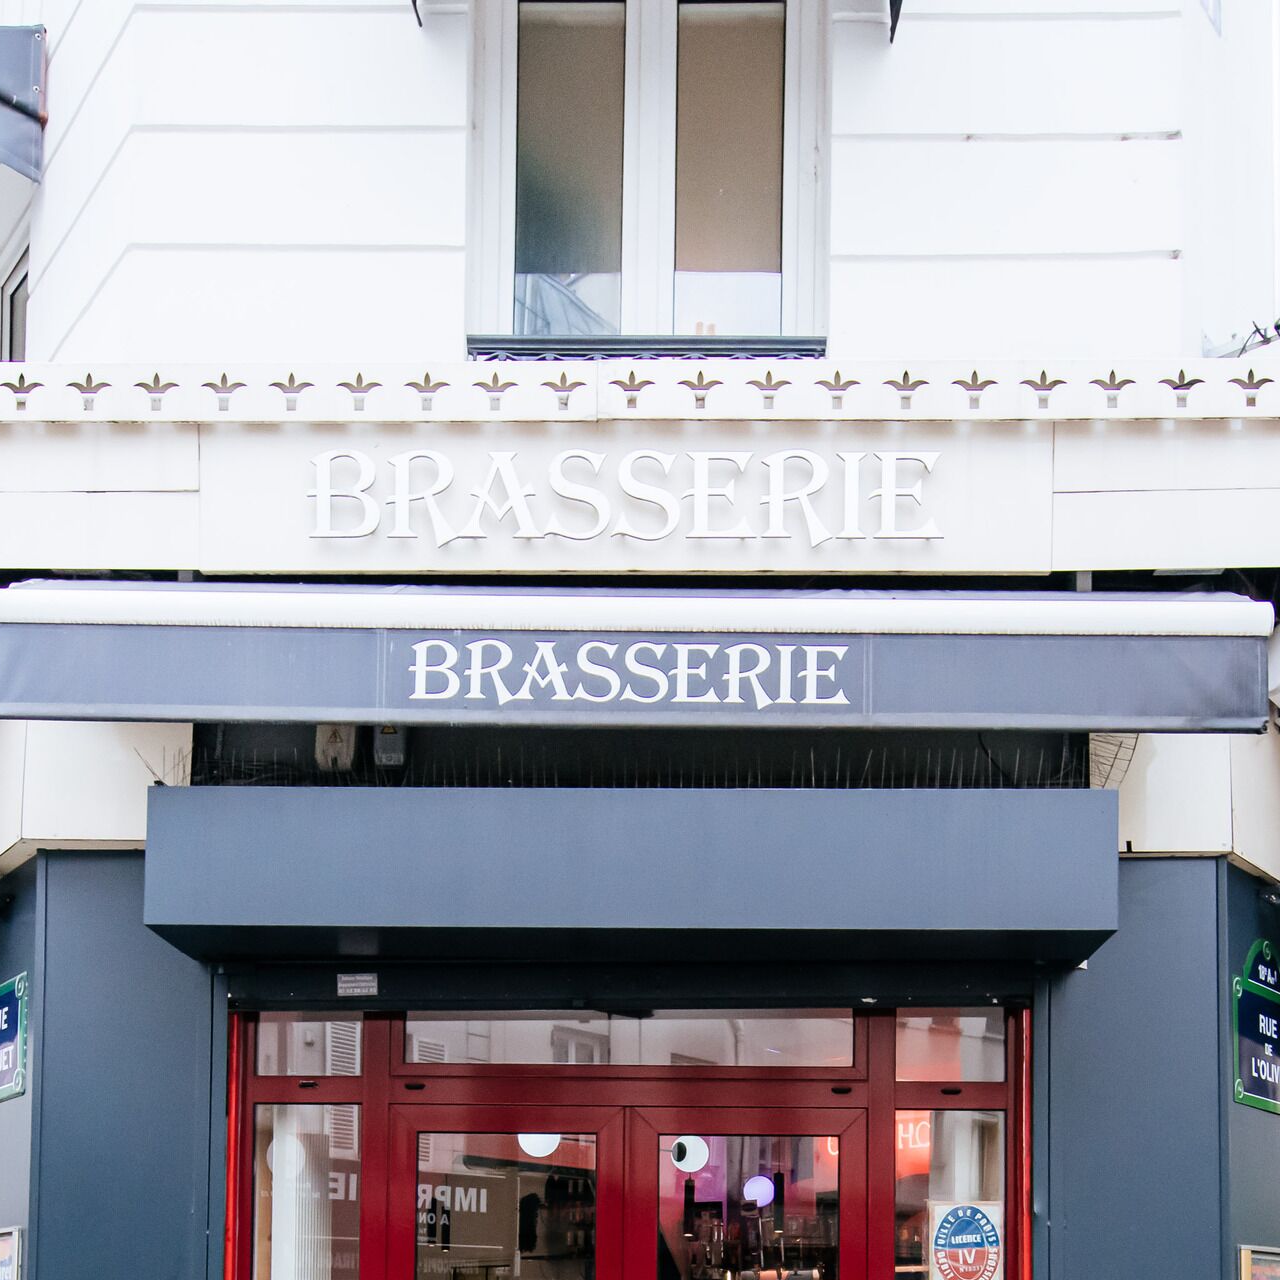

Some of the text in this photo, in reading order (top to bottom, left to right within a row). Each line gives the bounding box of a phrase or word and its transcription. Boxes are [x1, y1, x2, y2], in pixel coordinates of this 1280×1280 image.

[306, 448, 945, 548] BRASSERIE
[407, 639, 851, 709] BRASSERIE
[1259, 1013, 1278, 1039] RUE
[1264, 1042, 1273, 1057] DE
[937, 1209, 997, 1245] VILLE DE PARIS
[951, 1233, 981, 1245] LICENCE
[959, 1248, 976, 1265] IV
